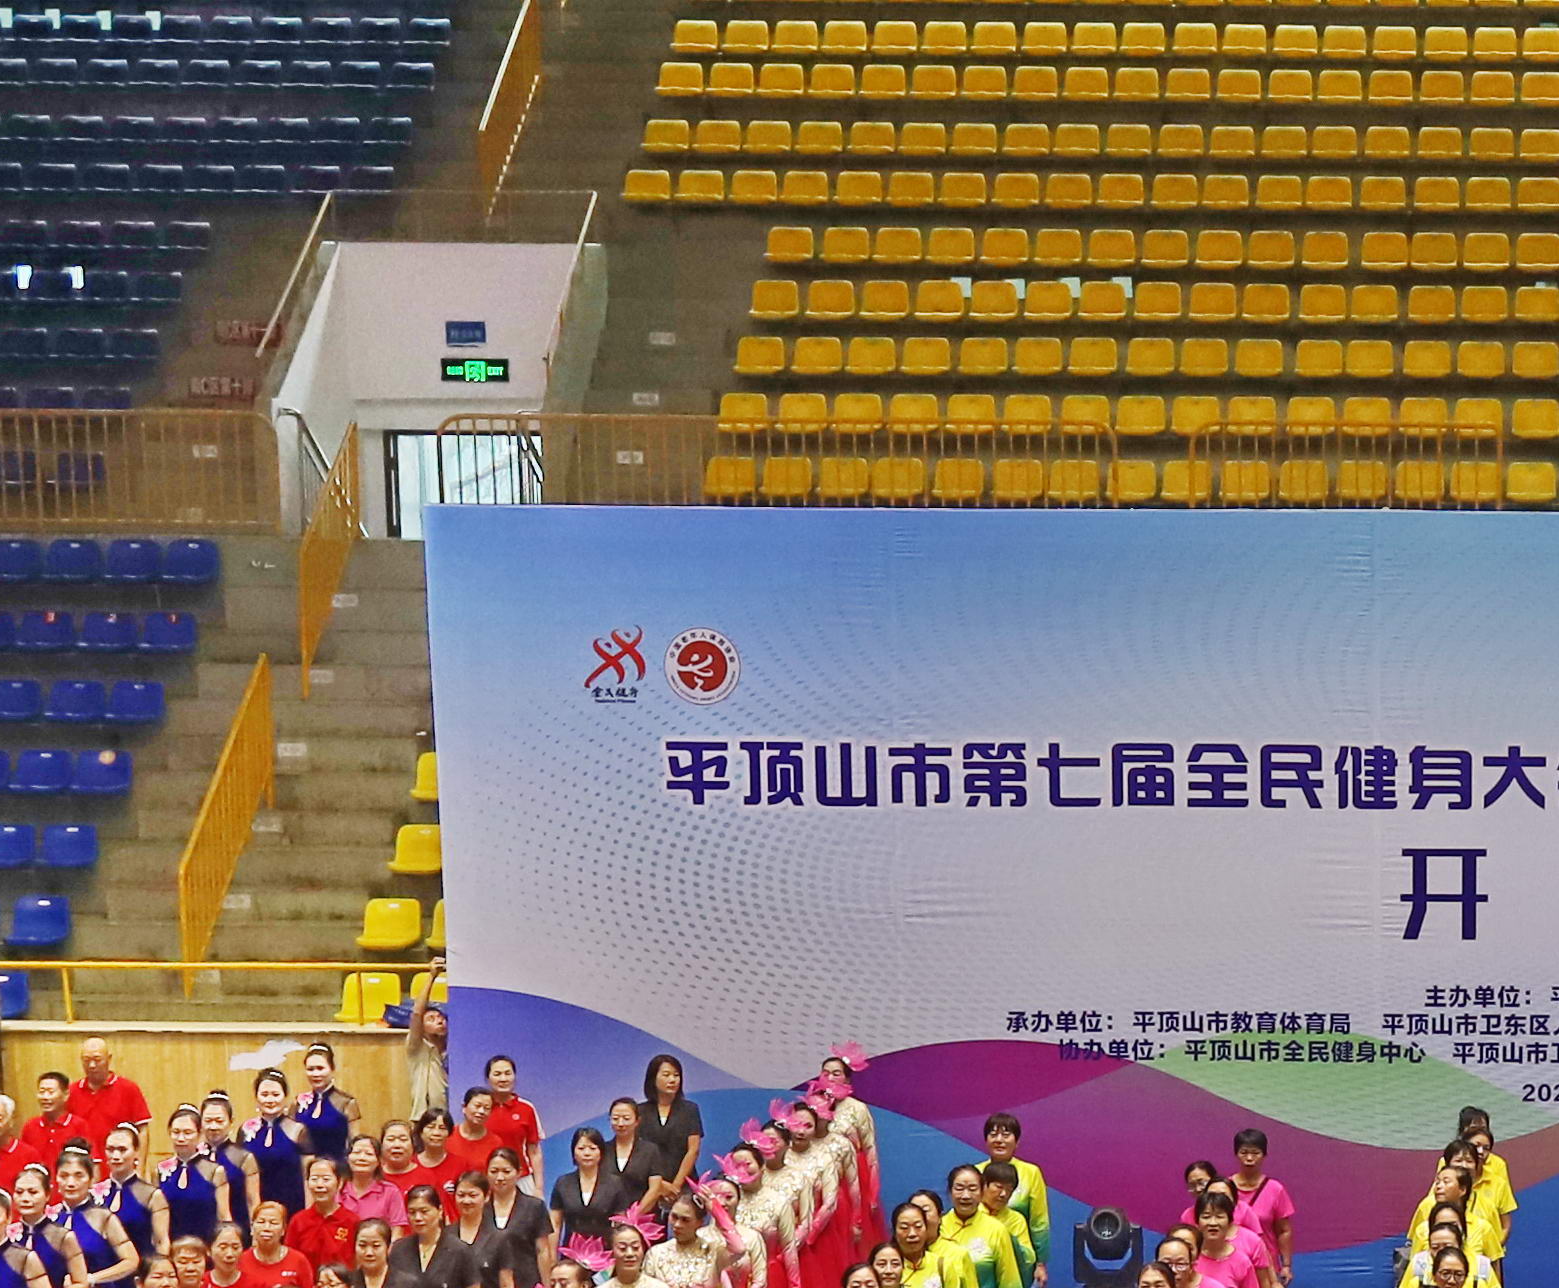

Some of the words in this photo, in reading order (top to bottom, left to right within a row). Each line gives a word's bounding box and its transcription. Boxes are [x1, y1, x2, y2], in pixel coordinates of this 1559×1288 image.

[1006, 1010, 1352, 1036] 承办单位：平顶山市教育体育局
[1058, 1038, 1426, 1064] 协办单位：平顶山市全民健身中心
